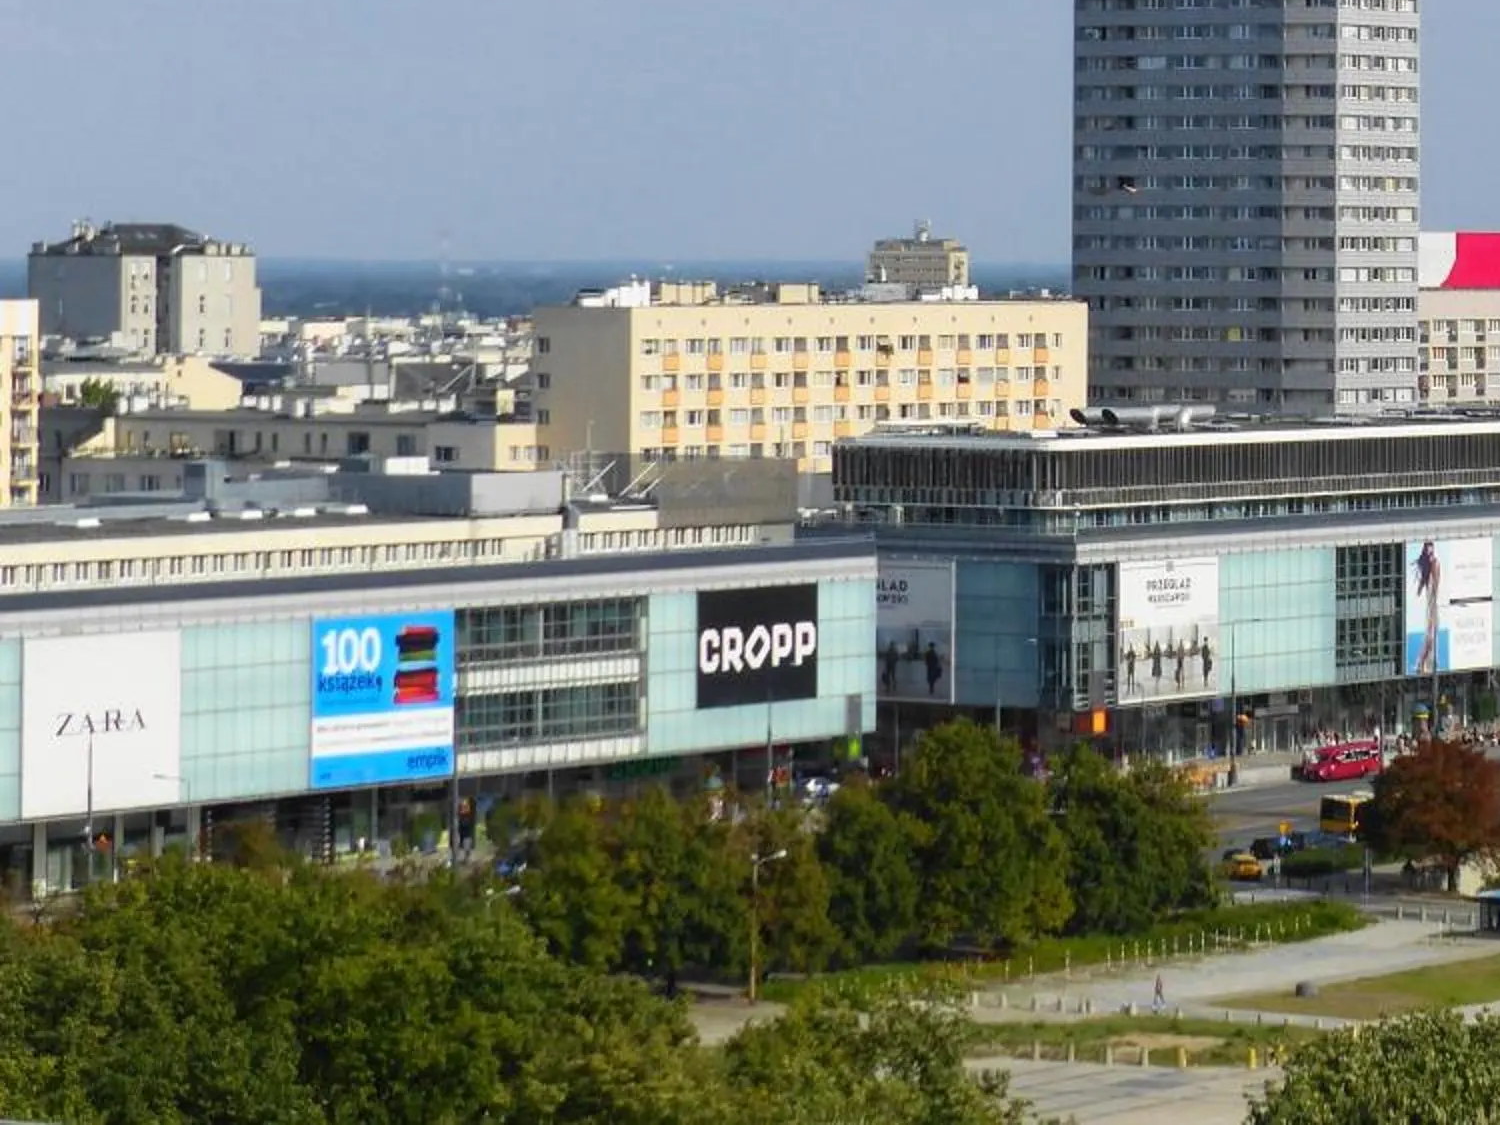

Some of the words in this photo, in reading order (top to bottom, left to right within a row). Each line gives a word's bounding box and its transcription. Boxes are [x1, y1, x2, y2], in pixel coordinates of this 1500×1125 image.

[321, 627, 382, 675] 100
[700, 621, 817, 673] CROPP
[55, 708, 146, 736] ZARA
